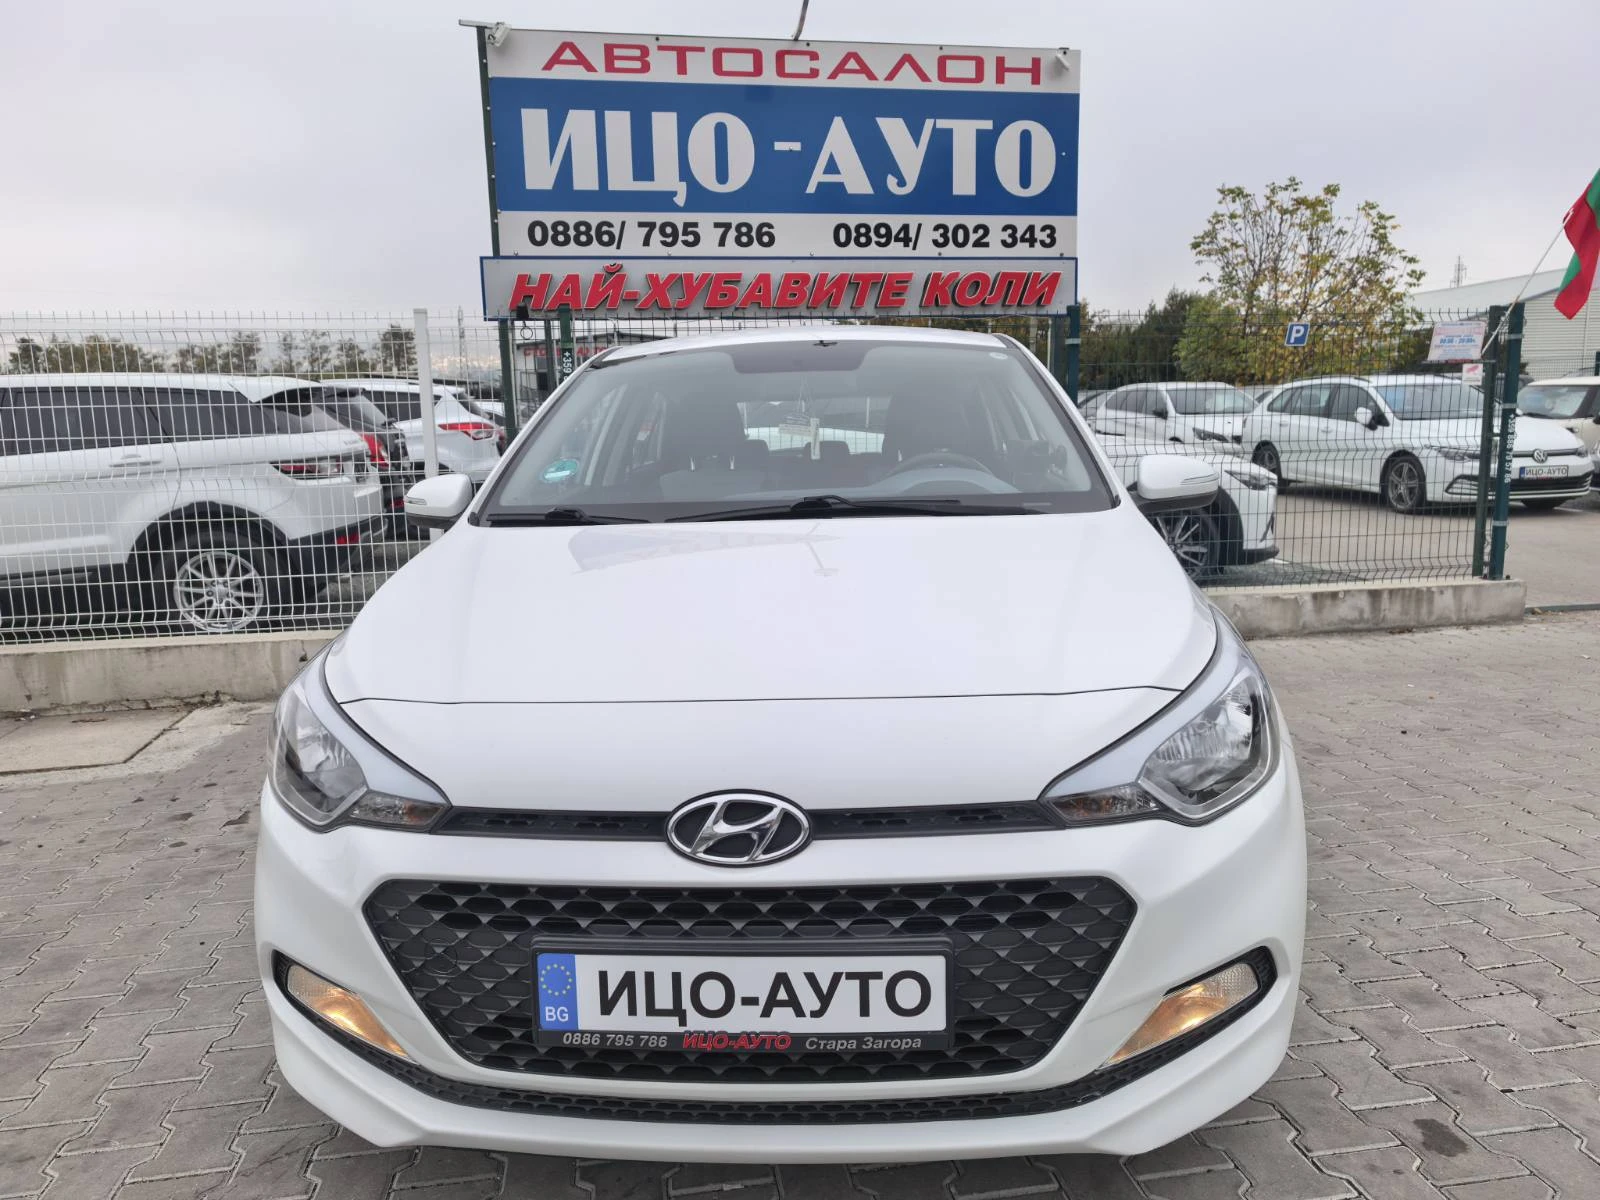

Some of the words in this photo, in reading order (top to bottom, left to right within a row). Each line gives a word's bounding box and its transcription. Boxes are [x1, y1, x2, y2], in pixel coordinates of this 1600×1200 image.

[541, 41, 1041, 85] АВТОСАЛОН
[527, 220, 626, 250] 0886/
[637, 221, 701, 248] 795
[713, 222, 776, 248] 786
[833, 222, 922, 250] 0894/
[931, 223, 990, 249] 302
[1000, 224, 1057, 249] 343
[508, 262, 914, 311] НАЙ-ХУБАВИТЕ
[919, 271, 1062, 308] КОЛИ
[1289, 325, 1305, 343] P
[563, 351, 573, 373] +359
[1526, 467, 1567, 476] ИЦО-АУТО
[598, 970, 932, 1027] ИЦО-АУТО
[545, 1006, 569, 1022] BG
[562, 1032, 601, 1045] 0886
[605, 1034, 637, 1047] 795
[639, 1035, 668, 1048] 786
[682, 1031, 792, 1051] ИЦО-АУТО
[805, 1037, 857, 1051] Стара
[862, 1036, 922, 1050] Загора
